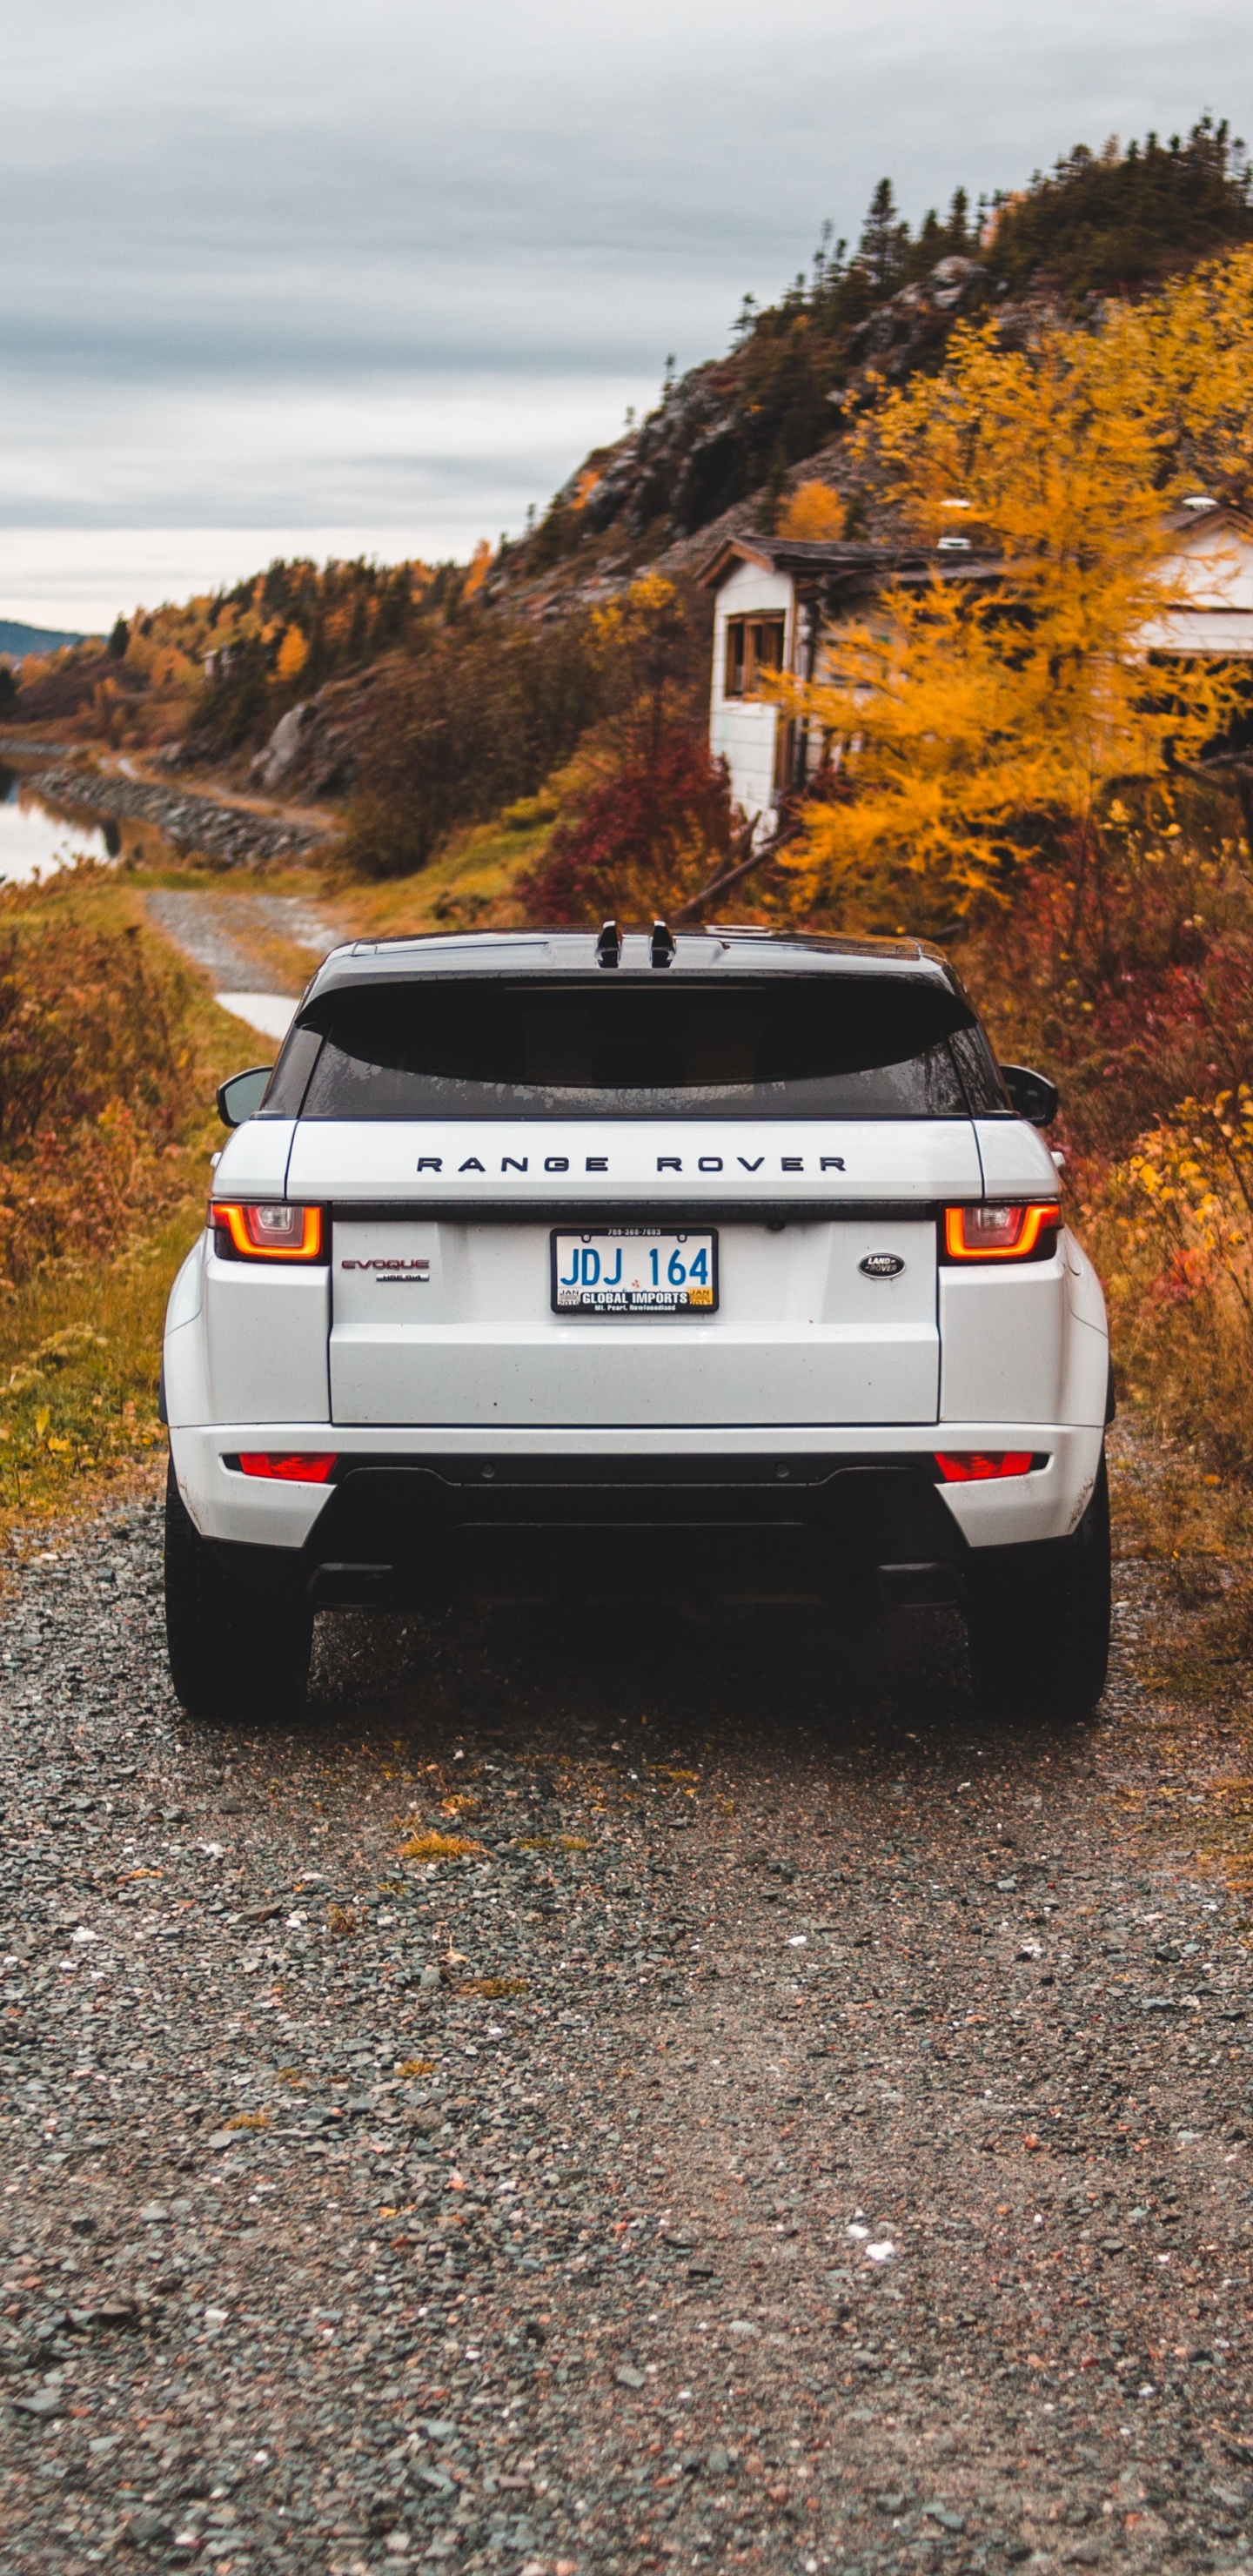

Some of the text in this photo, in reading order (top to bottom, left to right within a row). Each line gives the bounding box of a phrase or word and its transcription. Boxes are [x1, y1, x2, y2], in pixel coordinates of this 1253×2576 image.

[416, 1157, 848, 1172] RANGE ROVER
[341, 1259, 430, 1270] EVOQUE
[559, 1248, 708, 1286] JDJ 164
[582, 1292, 628, 1304] GLOBAL
[632, 1292, 688, 1304] IMPORTS
